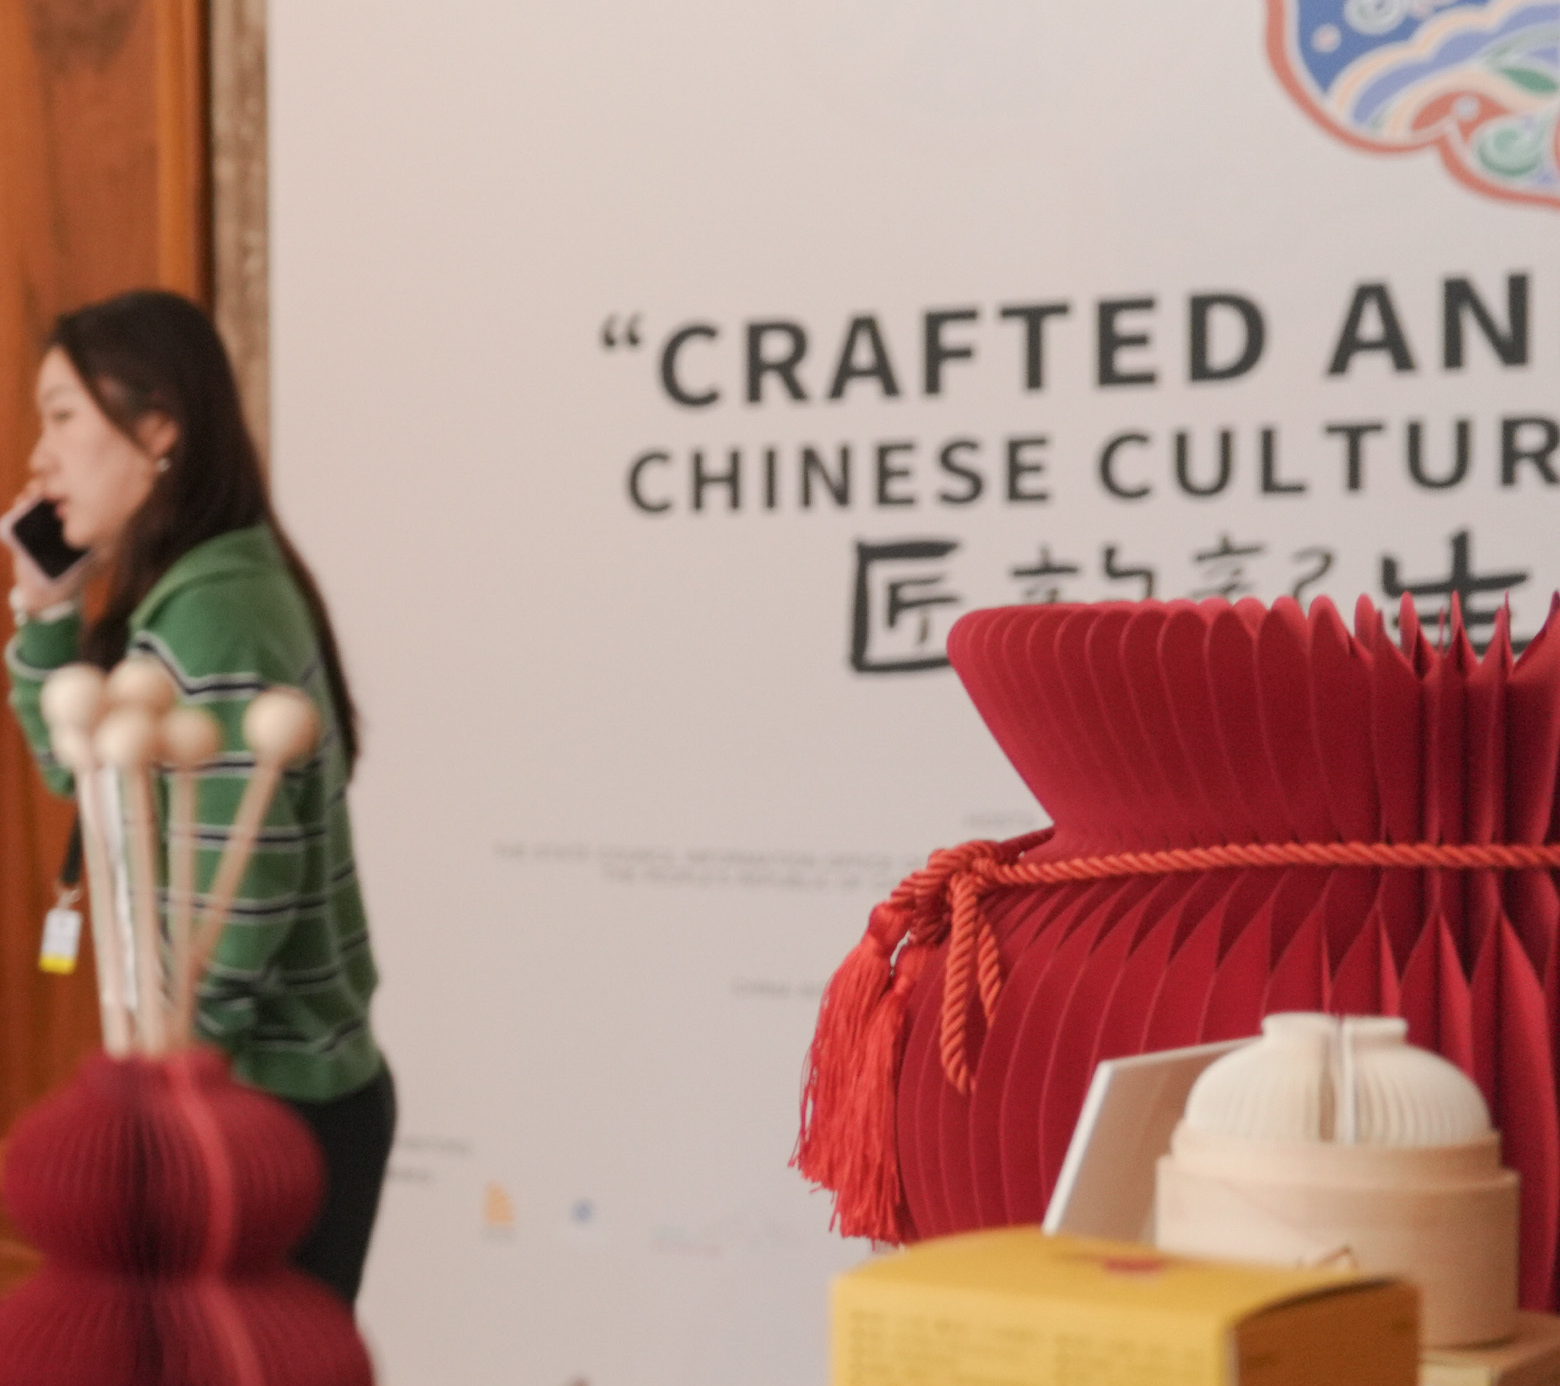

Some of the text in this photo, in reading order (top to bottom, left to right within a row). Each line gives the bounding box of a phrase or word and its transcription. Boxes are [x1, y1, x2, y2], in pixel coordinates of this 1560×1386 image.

[601, 273, 1530, 408] “CRAFTED AN
[627, 415, 1560, 514] CHINESE CULTUR
